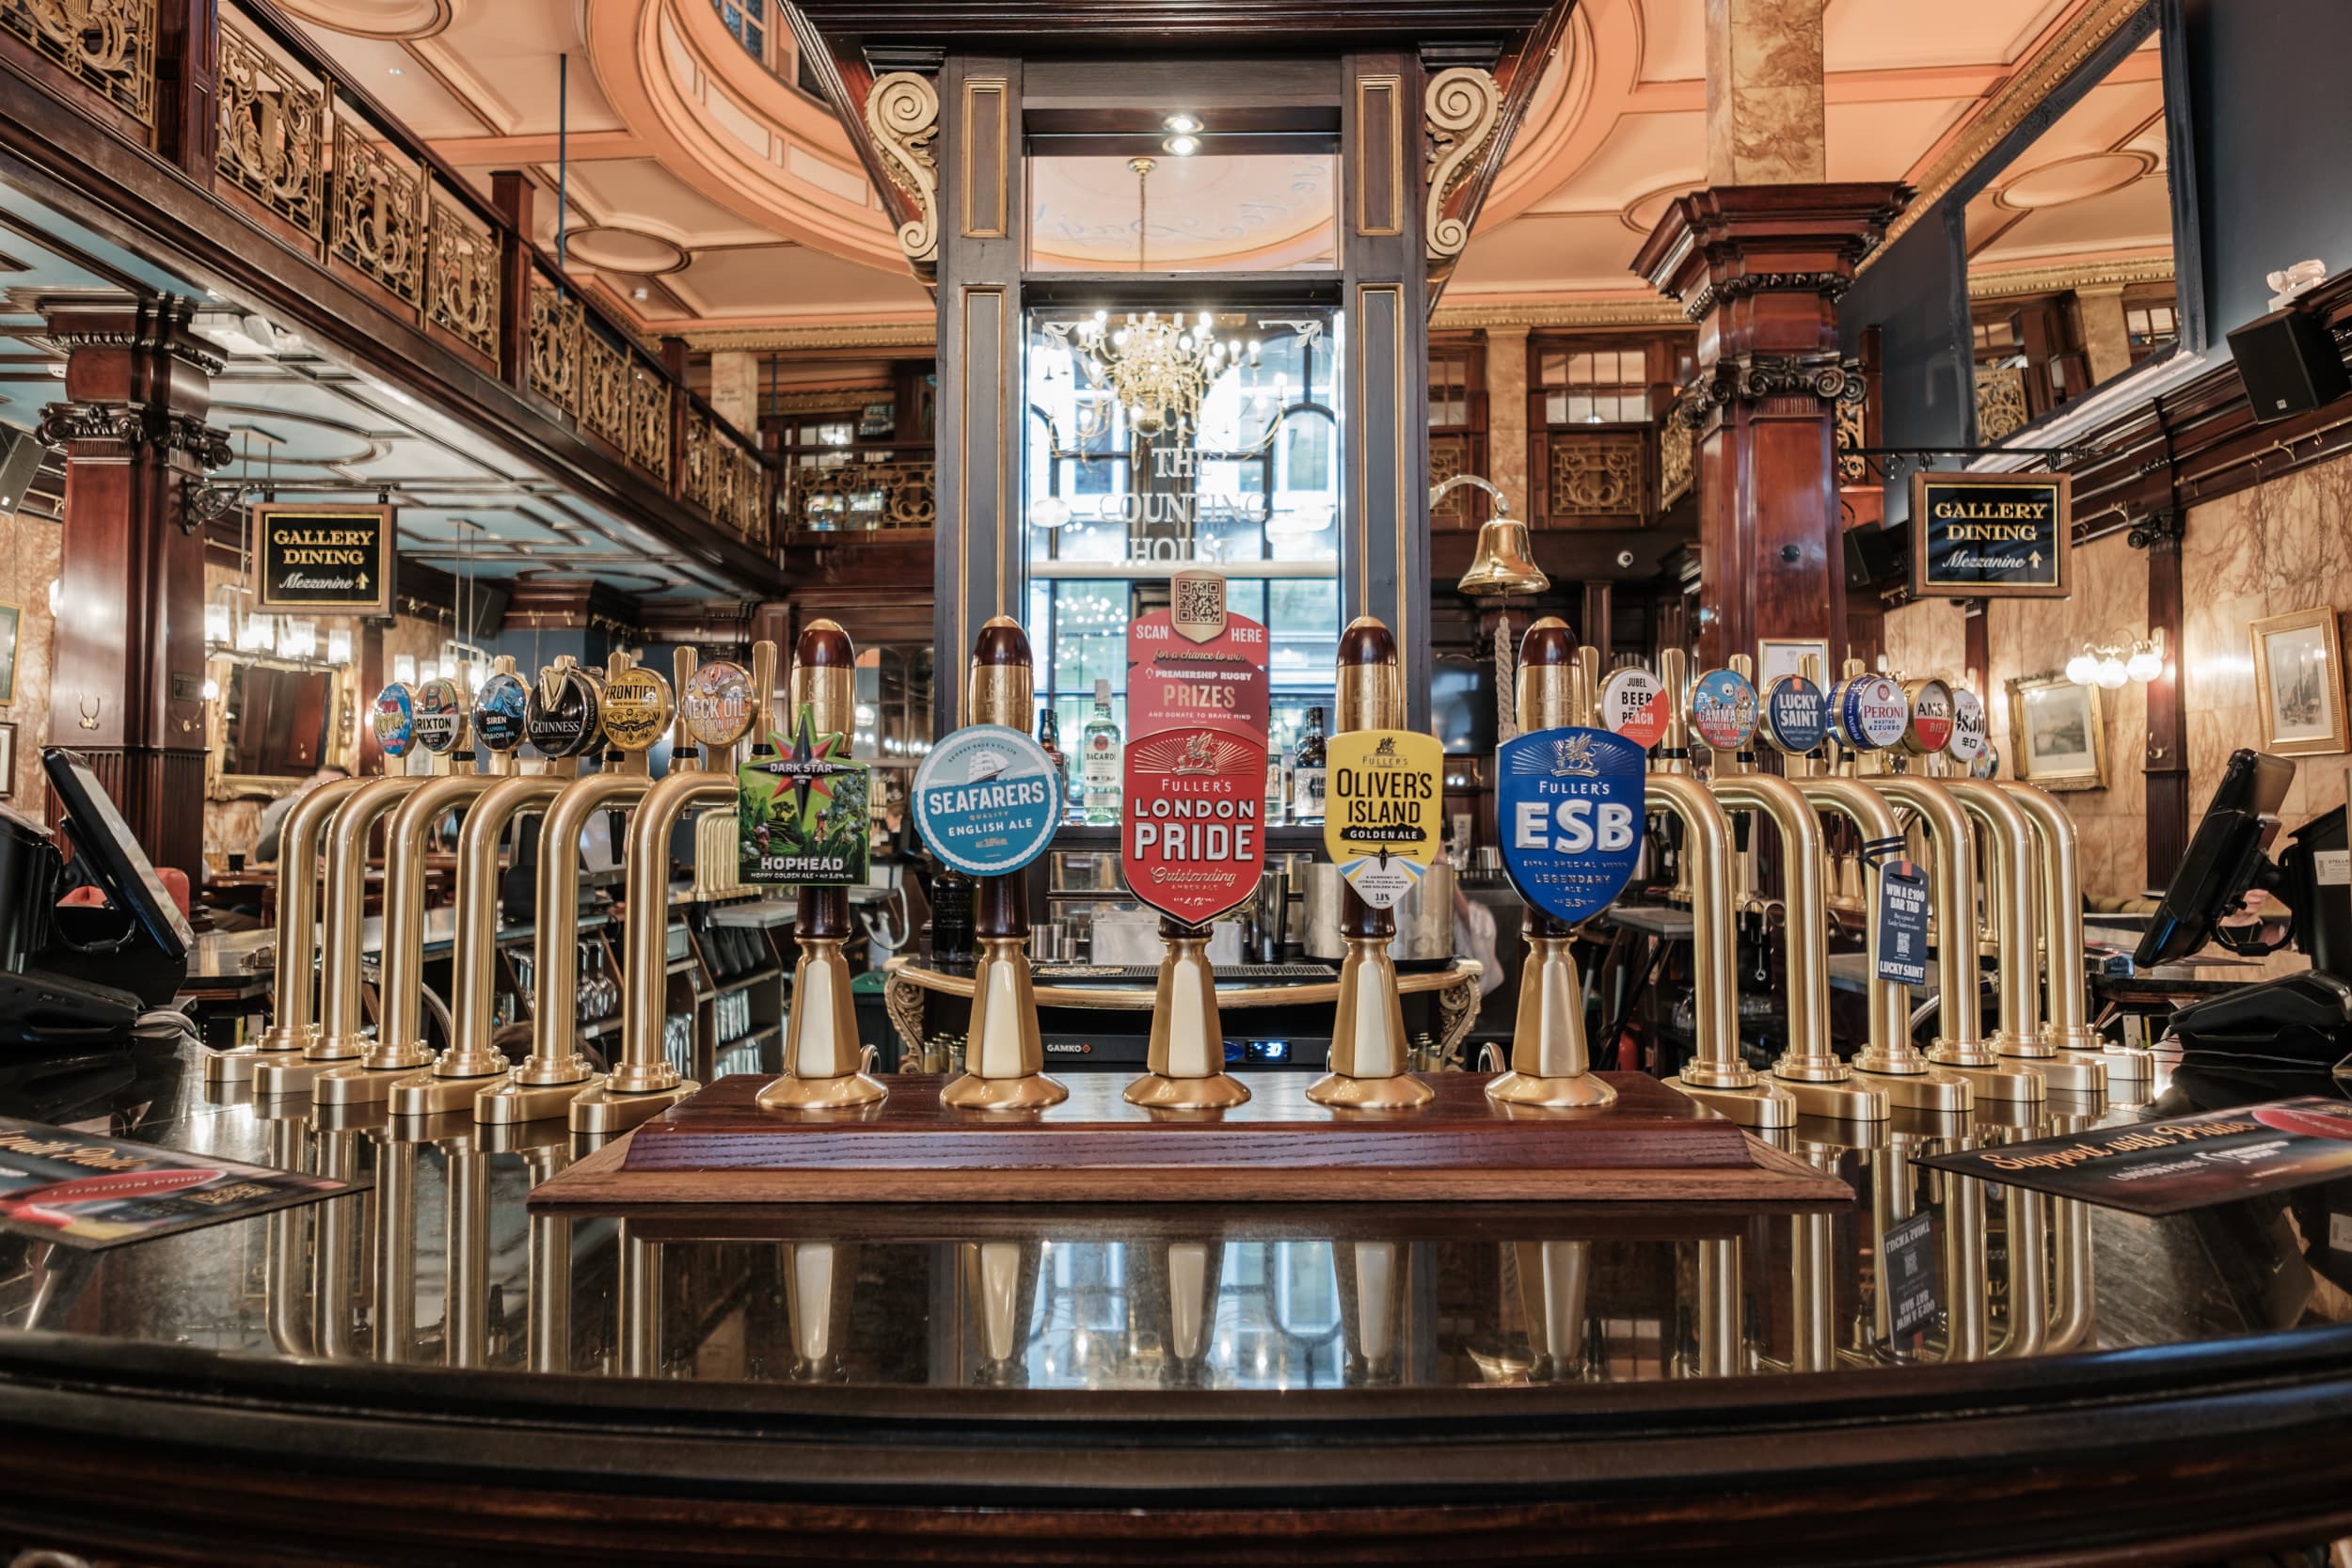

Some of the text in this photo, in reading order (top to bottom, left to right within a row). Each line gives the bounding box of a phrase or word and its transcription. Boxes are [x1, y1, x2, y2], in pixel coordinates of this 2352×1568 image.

[1152, 448, 1211, 478] THE
[1099, 493, 1266, 523] COUNTING
[1934, 502, 2047, 519] GALLERY
[274, 530, 374, 546] GALLERY
[1947, 524, 2038, 542] DINING
[283, 548, 365, 565] DINING
[1129, 537, 1234, 566] HOUSE
[1942, 549, 2026, 568] Mezzanine
[278, 572, 354, 590] Mezzanine
[1136, 625, 1263, 643] SCAN HERE
[1181, 649, 1214, 660] chance
[1215, 649, 1225, 660] to
[1155, 670, 1252, 681] PREMIERSHIP RUGBY
[1627, 677, 1647, 688] JUBEL
[1163, 685, 1235, 708] PRIZES
[1621, 691, 1653, 706] BEER
[1779, 694, 1818, 709] LUCKY
[684, 697, 745, 720] NECK OIL
[1699, 707, 1737, 723] GAMMA
[1863, 705, 1904, 719] PERONI
[414, 717, 452, 731] BRIXTON
[485, 716, 507, 725] SIREN
[1622, 712, 1654, 725] PEACH
[1780, 709, 1819, 727] SAINT
[530, 721, 580, 734] GUINNESS
[770, 763, 833, 773] DARK STAR
[1161, 778, 1232, 793] FULLER'S
[1337, 768, 1432, 799] OLIVER'S
[1539, 780, 1611, 796] FULLER'S
[930, 781, 1045, 816] SEAFARERS
[969, 811, 1009, 821] QUALITY
[1134, 798, 1254, 818] LONDON
[1348, 800, 1421, 824] ISLAND
[947, 818, 1033, 836] ENGLISH ALE
[1349, 830, 1418, 840] GOLDEN ALE
[1515, 799, 1634, 854] ESB
[1134, 822, 1254, 861] PRIDE
[760, 857, 844, 871] HOPHEAD
[1553, 860, 1597, 868] SPECIAL
[1150, 866, 1236, 887] Outstanding
[1534, 873, 1611, 884] LEGENDARY
[1886, 882, 1926, 903] WIN A £100
[1890, 896, 1920, 913] BAR TAB
[1880, 960, 1903, 975] LUCKY
[1903, 965, 1924, 979] SAINT
[1046, 1044, 1082, 1053] GAMKO
[1979, 1143, 2113, 1170] Support
[2106, 1132, 2177, 1151] with
[2153, 1121, 2256, 1140] Pride
